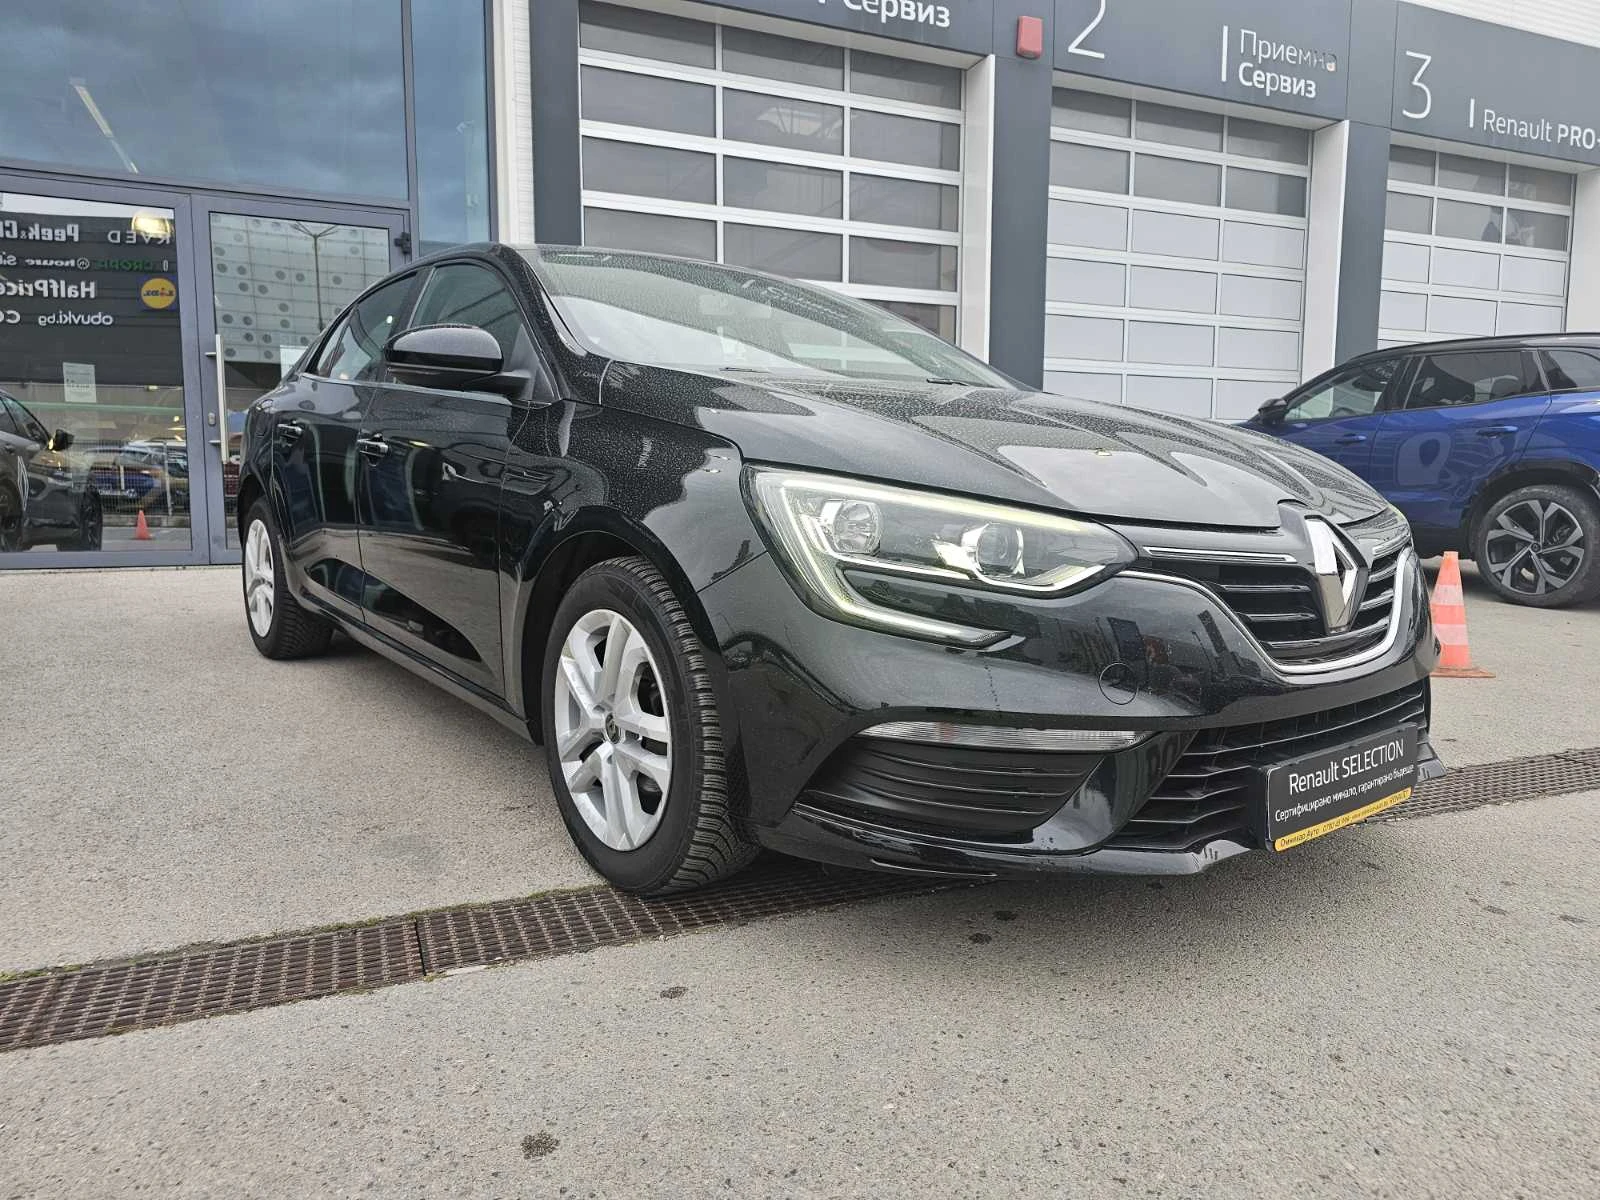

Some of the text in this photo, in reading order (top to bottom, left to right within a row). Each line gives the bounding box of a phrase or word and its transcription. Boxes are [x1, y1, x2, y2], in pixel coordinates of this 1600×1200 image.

[1068, 0, 1106, 59] 2
[1238, 62, 1317, 99] Сервиз
[1402, 50, 1432, 119] 3
[1483, 108, 1552, 142] Renault
[1289, 738, 1404, 795] Renault SELECTION
